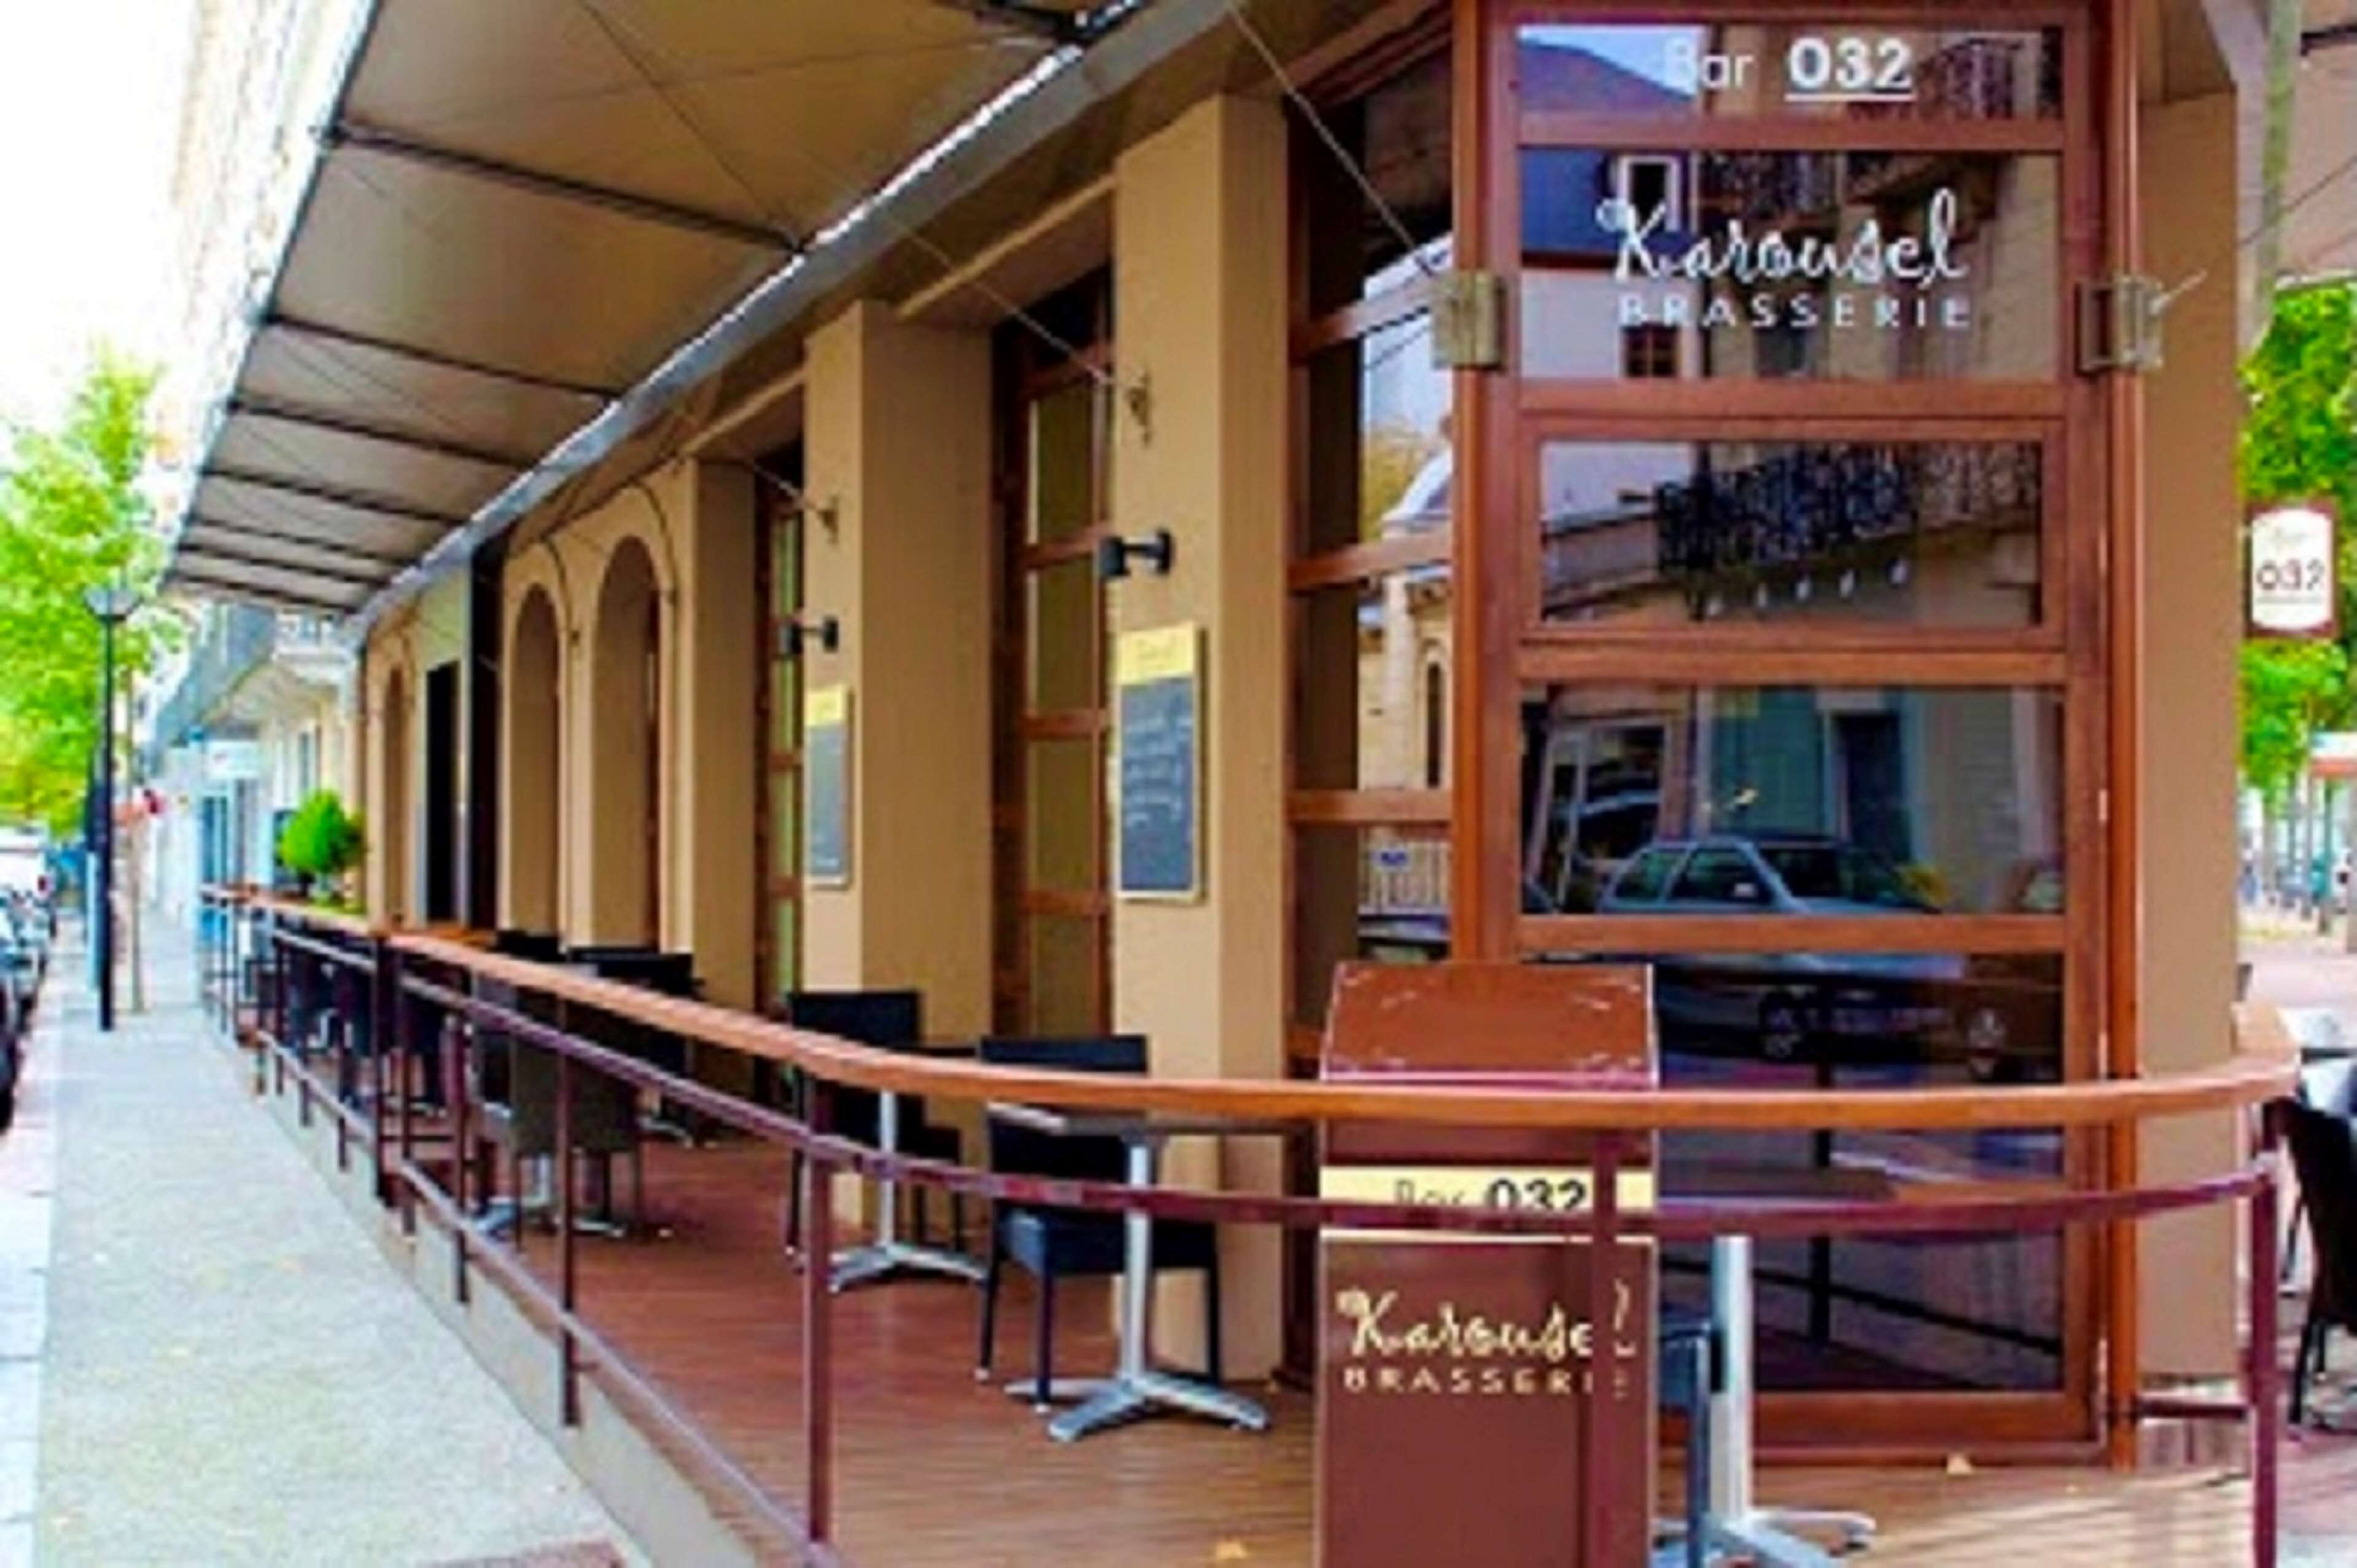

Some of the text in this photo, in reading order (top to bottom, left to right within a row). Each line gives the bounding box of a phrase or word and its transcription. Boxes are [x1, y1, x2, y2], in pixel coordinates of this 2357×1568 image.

[1664, 37, 1912, 89] Bar 032
[1596, 187, 1967, 287] Karousel
[1618, 294, 1969, 327] BRASSERIE
